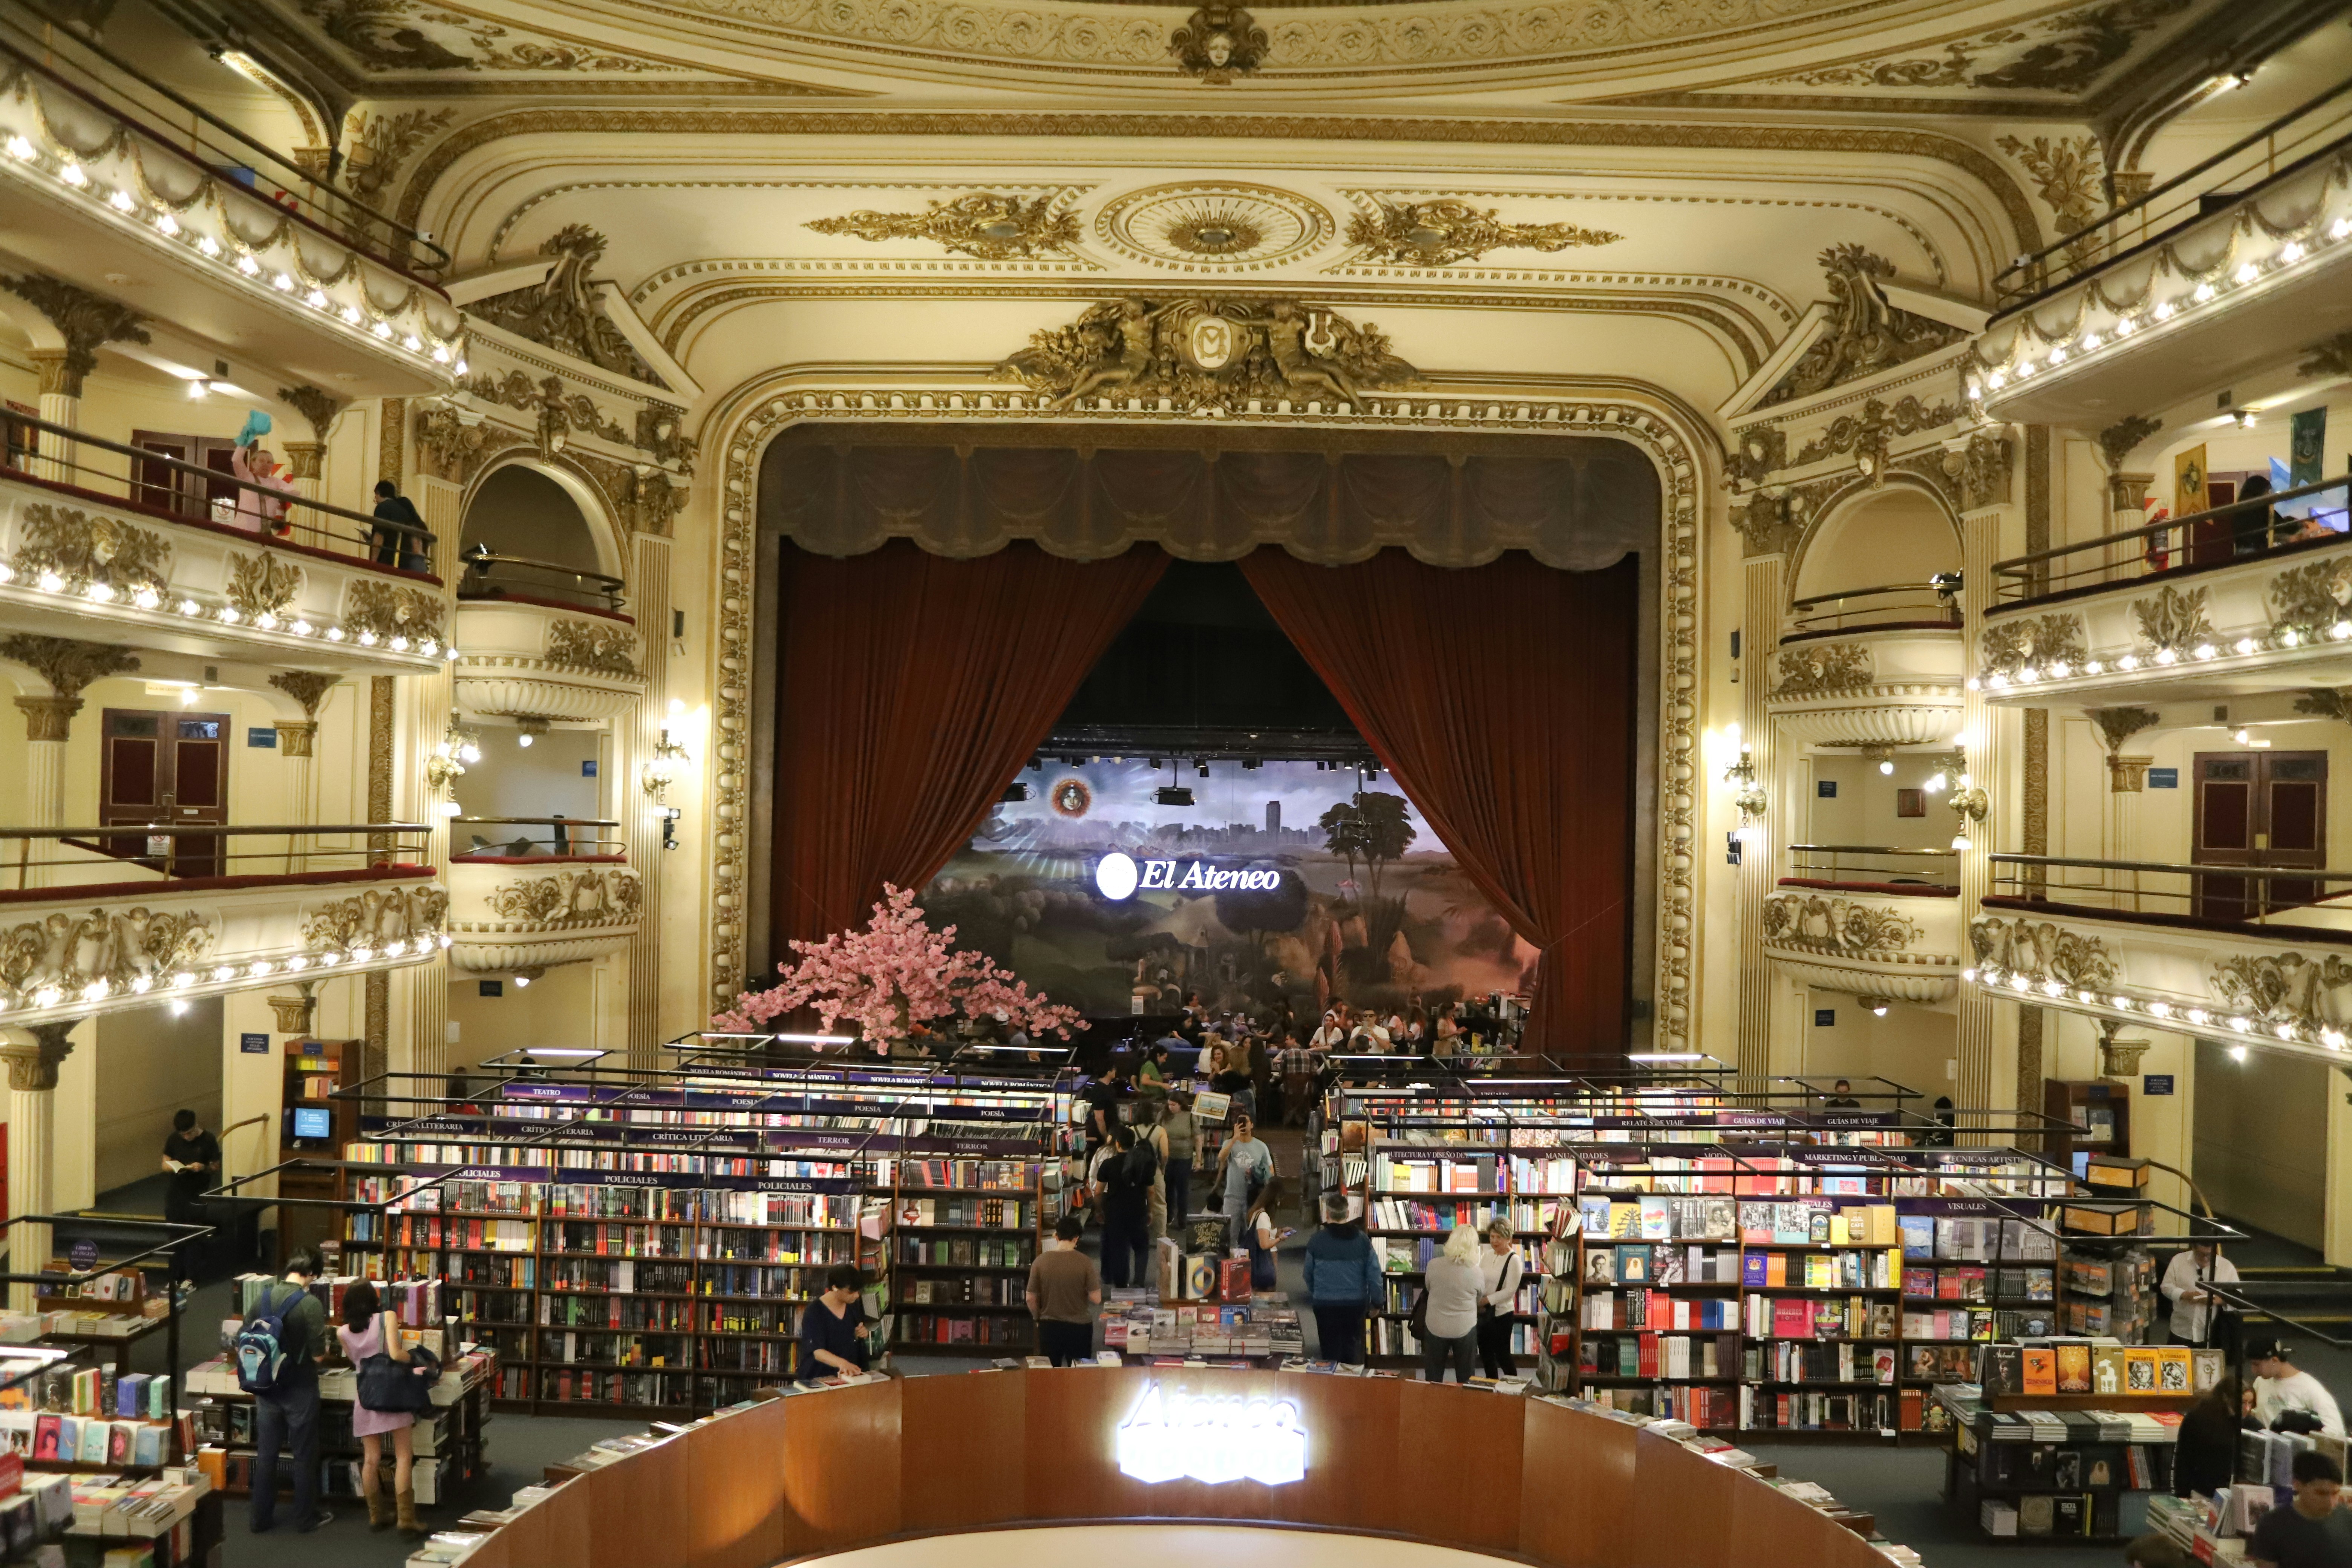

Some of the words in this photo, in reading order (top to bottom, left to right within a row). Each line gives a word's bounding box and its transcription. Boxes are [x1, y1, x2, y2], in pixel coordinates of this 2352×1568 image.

[1139, 861, 1174, 888] El
[1178, 861, 1280, 890] Ateneo
[715, 1069, 752, 1077] ROMÁNTICA
[386, 1120, 420, 1129] CRÍA
[521, 1125, 554, 1133] CRÍTICA
[652, 1132, 688, 1141] CRÍTICA
[817, 1136, 850, 1144] TERROR
[1804, 1154, 1851, 1162] MARKETING
[455, 1169, 501, 1178] OLICIALES
[605, 1174, 658, 1185] POLICIALES
[758, 1181, 812, 1191] POLICIALES
[1947, 1202, 1986, 1211] VISUALES
